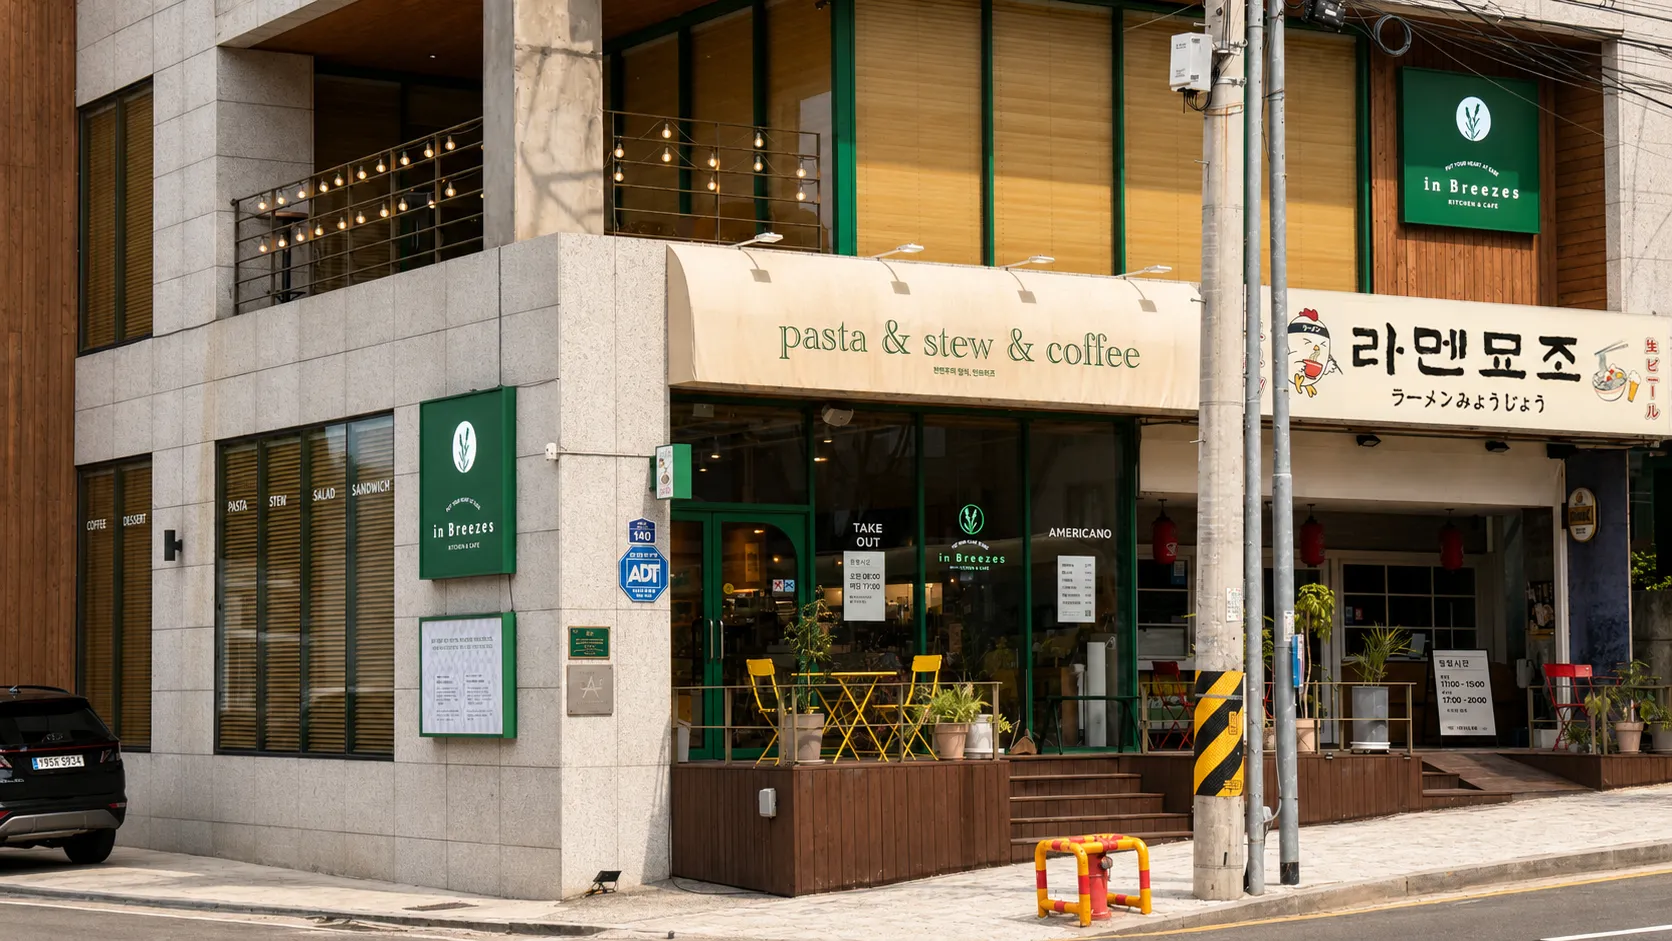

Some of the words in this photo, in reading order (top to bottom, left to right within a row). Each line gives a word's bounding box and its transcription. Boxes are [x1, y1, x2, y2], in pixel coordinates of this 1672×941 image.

[1424, 177, 1441, 192] in
[1450, 179, 1519, 199] Breezes
[779, 321, 868, 360] pasta
[882, 319, 911, 355] &
[923, 327, 995, 360] stew
[1007, 327, 1035, 363] &
[1046, 332, 1142, 369] coffee
[1645, 336, 1661, 421] 生ビール
[1391, 388, 1546, 414] ラーメンみょうじょう
[312, 488, 336, 501] SALAD
[352, 480, 390, 497] SANDWICH
[227, 500, 248, 513] PASTA
[433, 524, 444, 538] in
[448, 521, 494, 537] Breezes
[853, 522, 883, 533] TAKE
[1048, 527, 1112, 539] AMERICANO
[633, 531, 651, 541] 140
[856, 537, 880, 547] OUT
[939, 552, 950, 562] in
[956, 553, 1005, 563] Breezes
[628, 564, 660, 583] ADT
